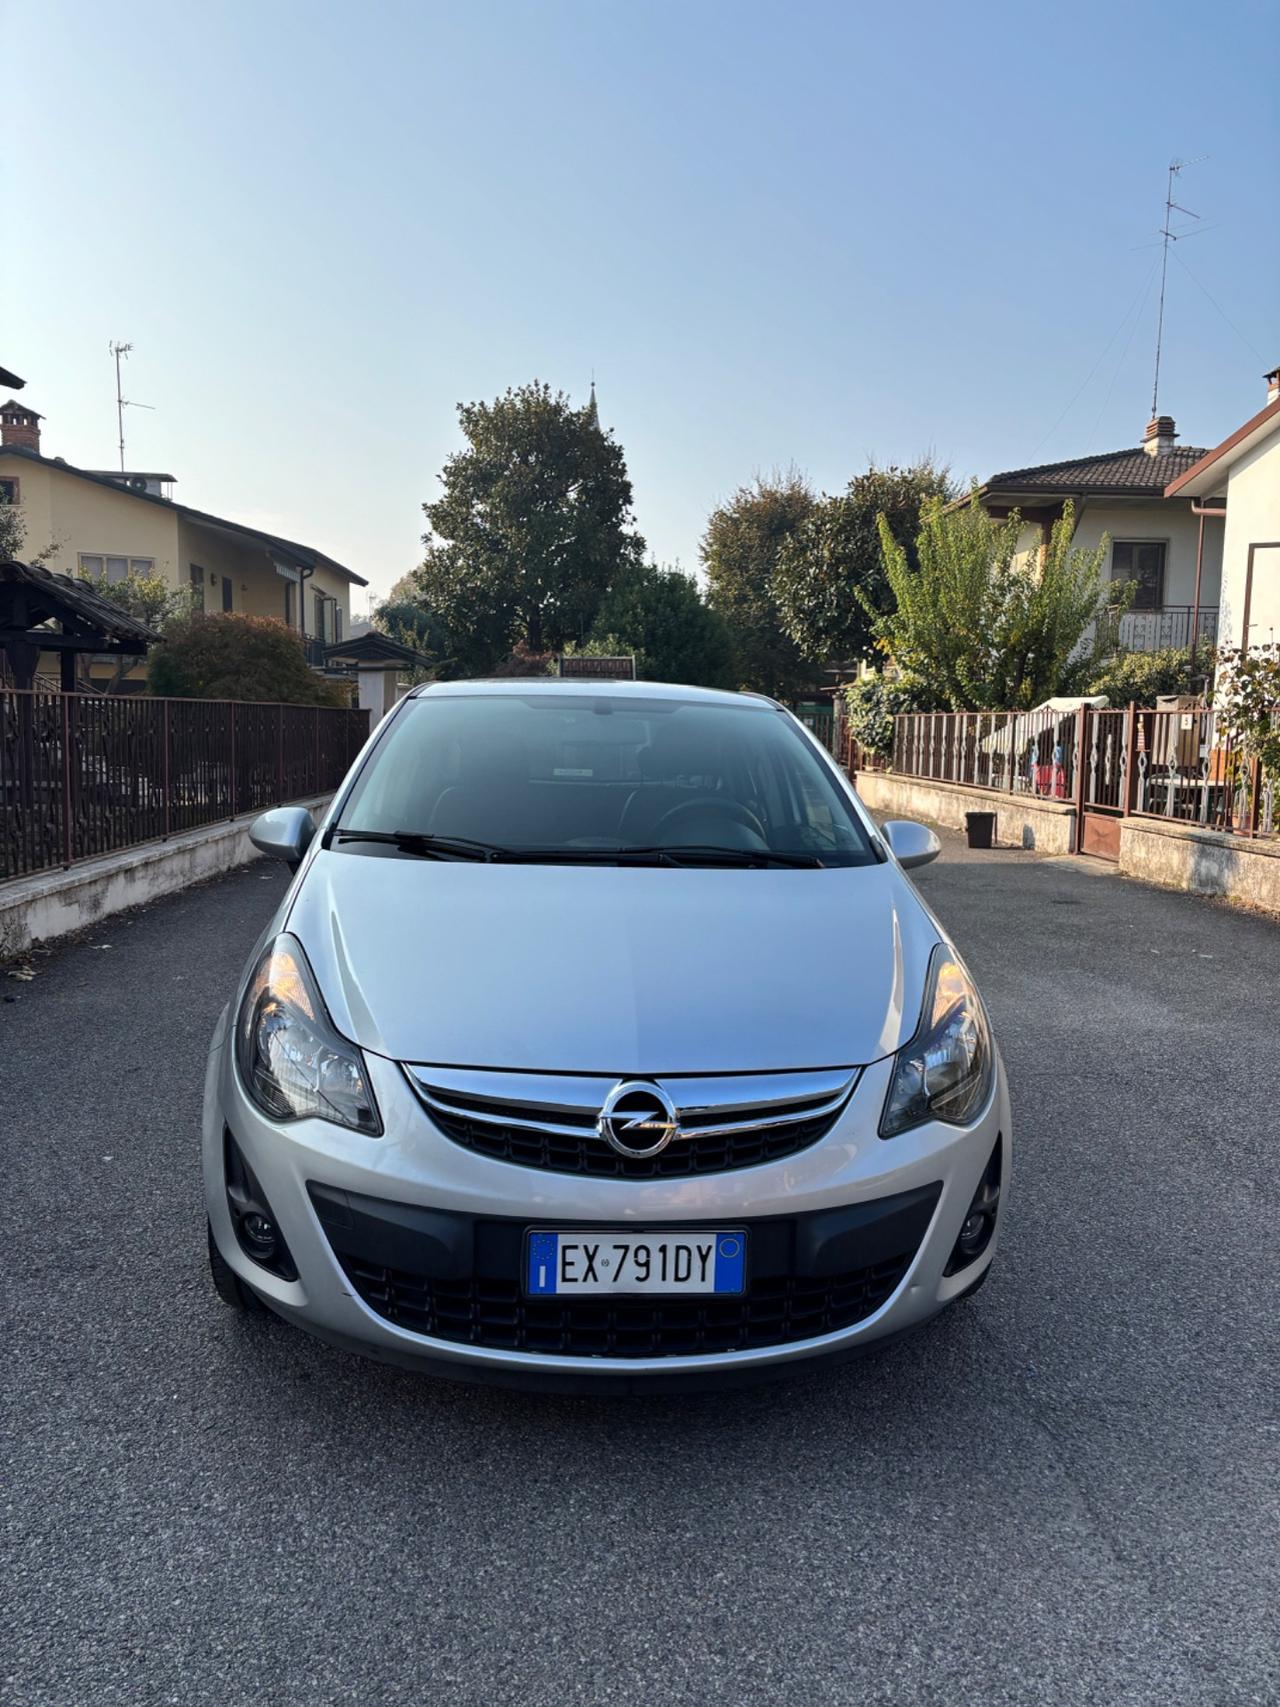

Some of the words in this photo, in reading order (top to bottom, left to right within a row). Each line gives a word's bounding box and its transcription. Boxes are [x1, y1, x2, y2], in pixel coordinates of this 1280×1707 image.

[539, 1265, 546, 1287] I
[561, 1244, 600, 1282] EX
[612, 1244, 713, 1282] 791DY
